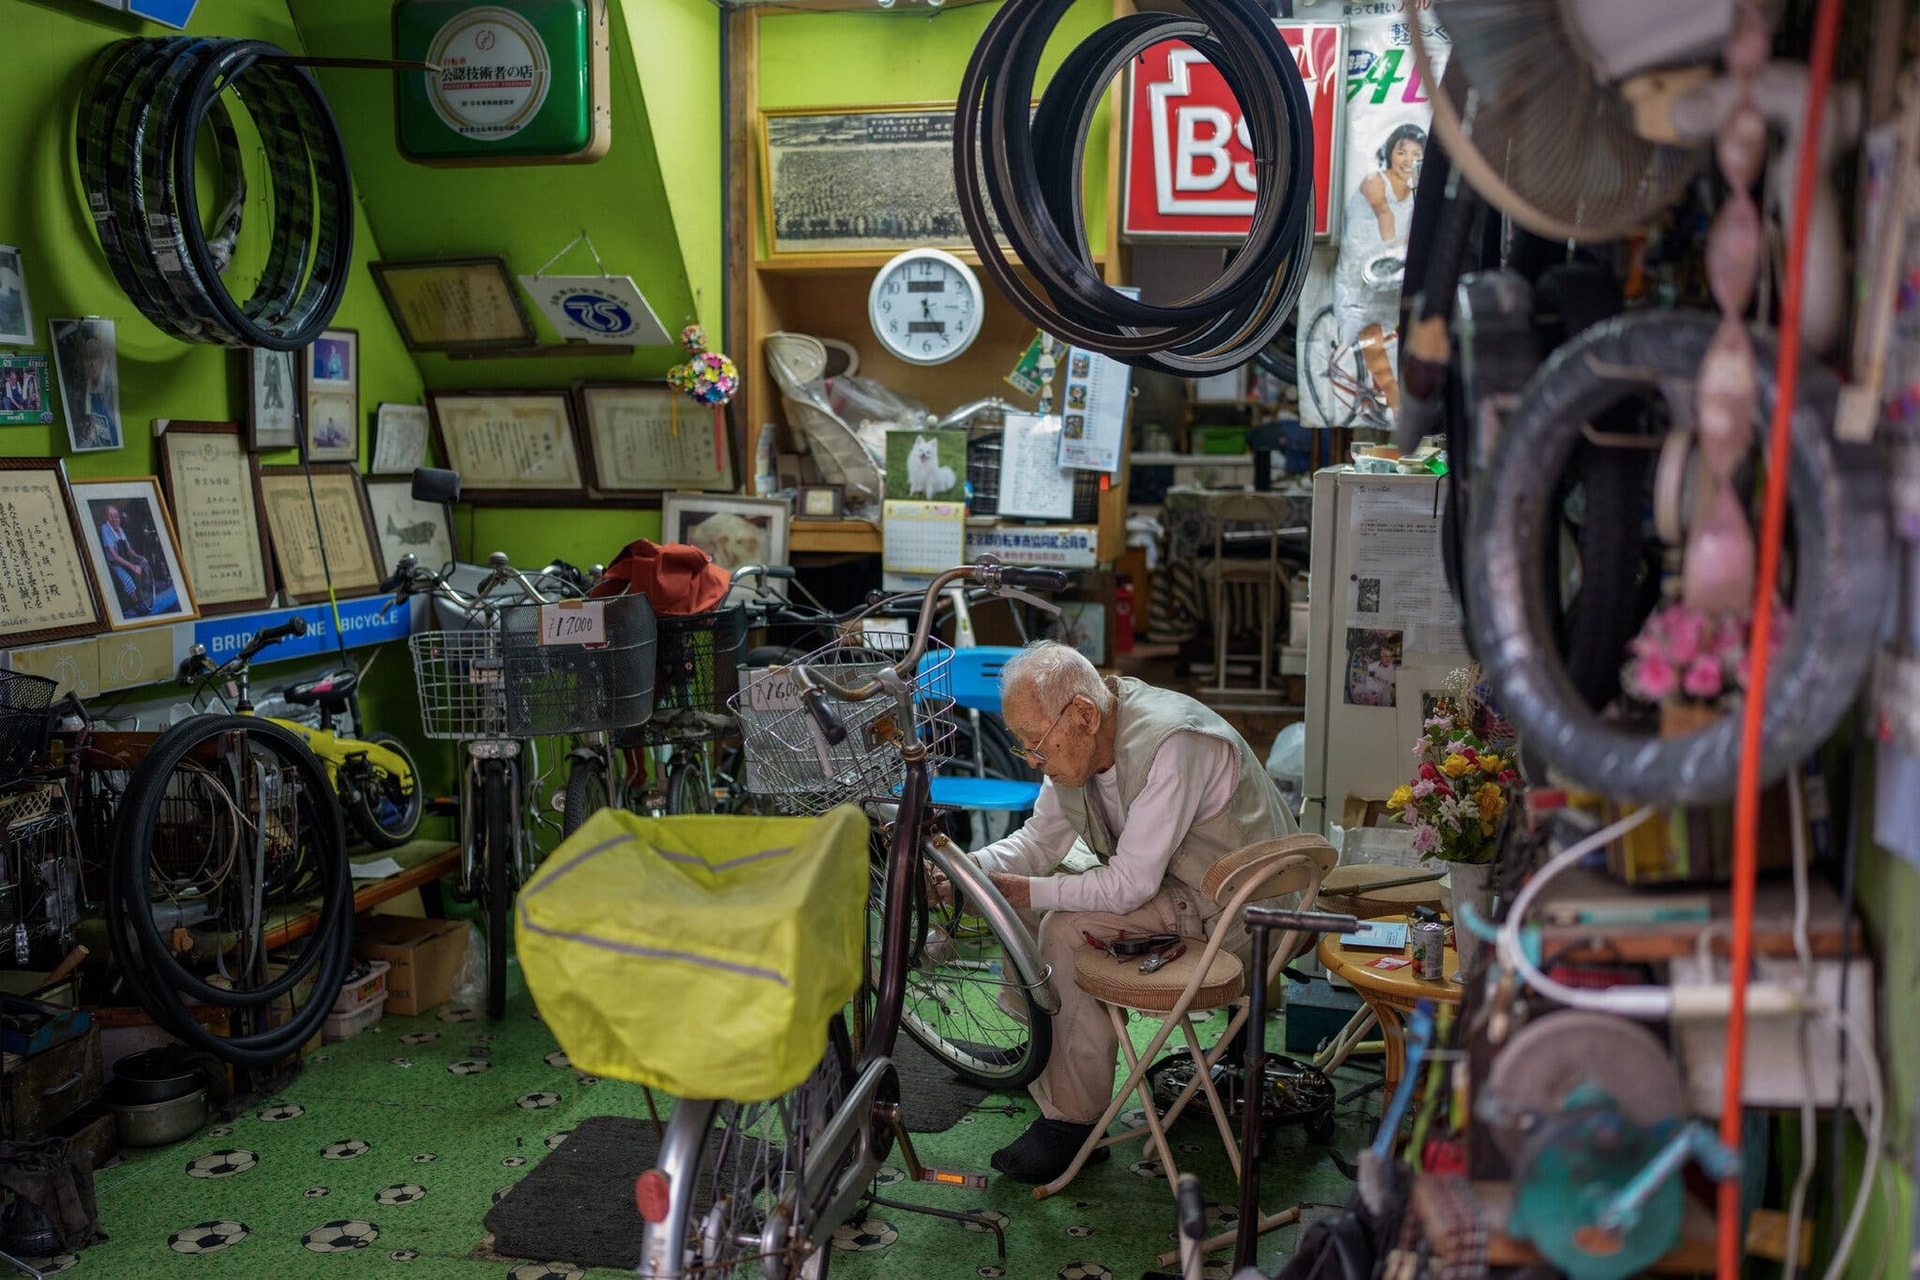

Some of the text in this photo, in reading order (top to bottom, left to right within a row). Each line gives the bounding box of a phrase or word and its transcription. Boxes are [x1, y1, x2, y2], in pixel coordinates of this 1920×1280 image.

[442, 66, 533, 82] 公認技術者の店
[902, 267, 911, 280] 11
[919, 262, 931, 275] 12
[943, 267, 947, 280] 1
[887, 281, 900, 295] 10
[955, 281, 963, 294] 2
[882, 301, 891, 313] 9
[962, 301, 970, 314] 3
[890, 320, 898, 333] 8
[955, 320, 963, 333] 4
[904, 334, 912, 346] 7
[922, 339, 931, 353] 6
[941, 333, 950, 347] 5
[212, 610, 398, 652] BRIDNE BICYCLE
